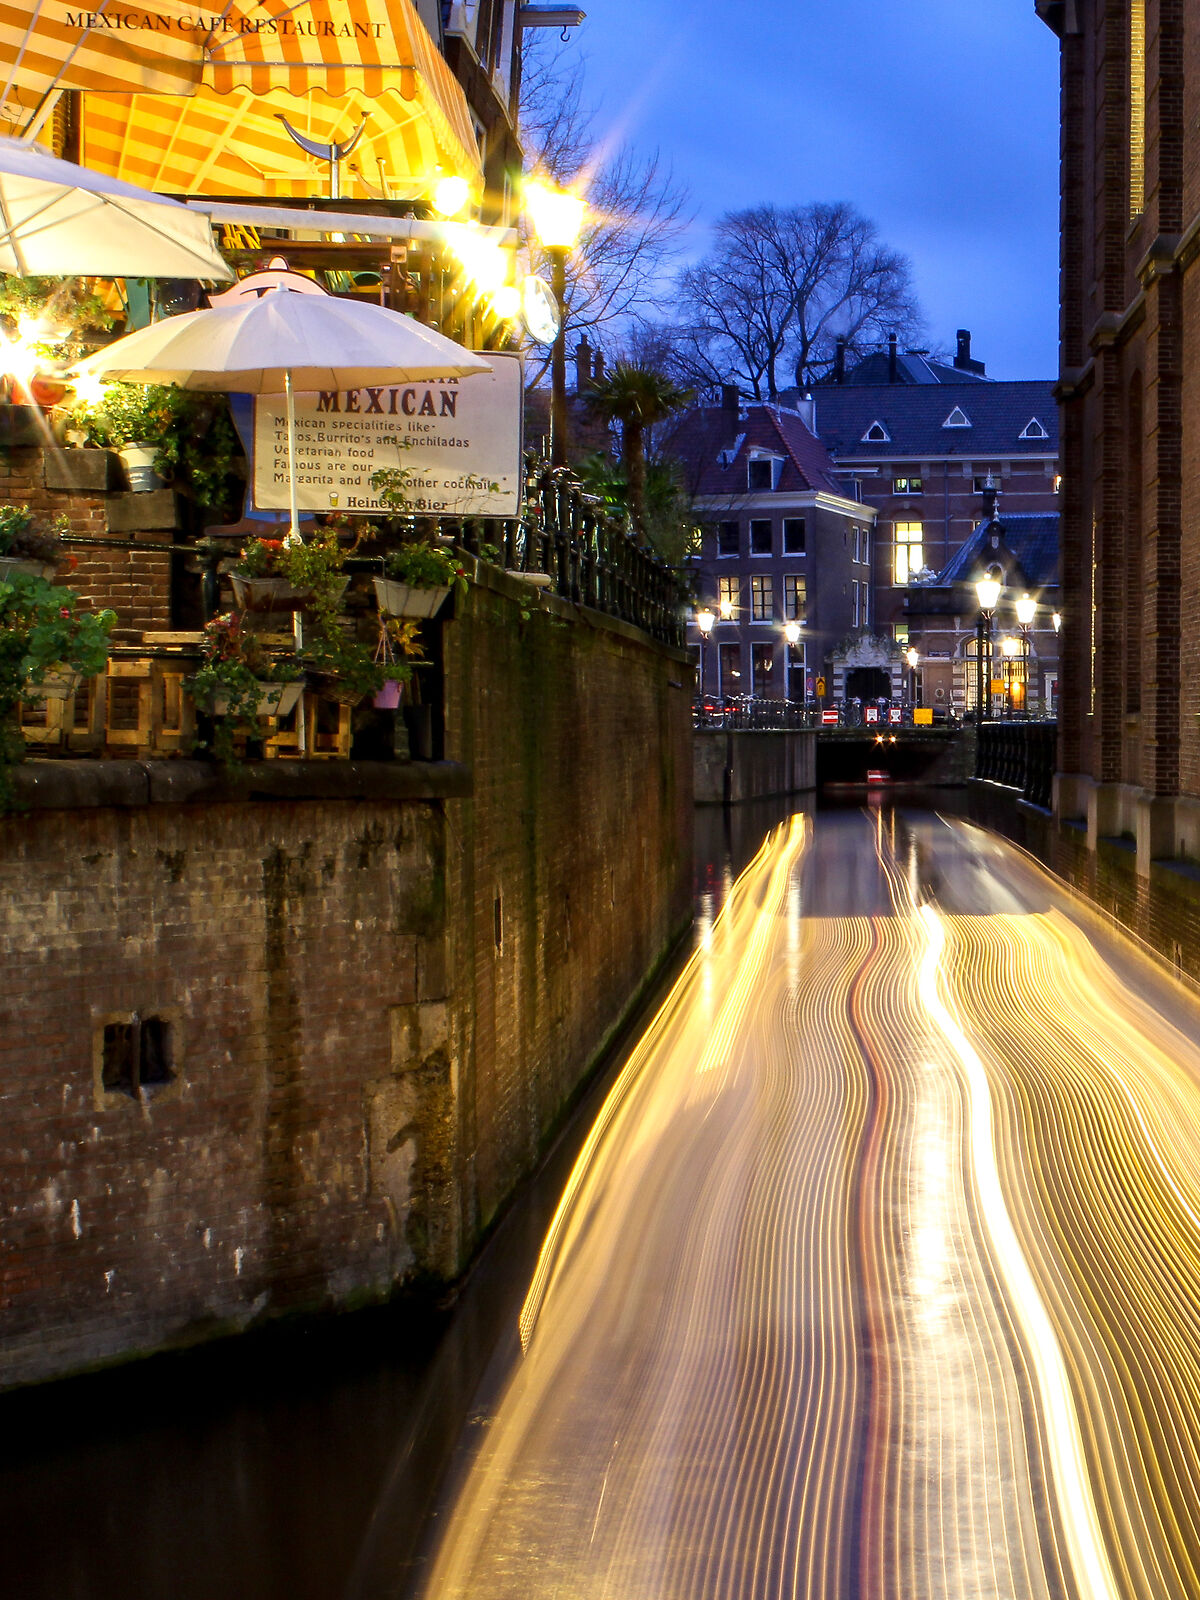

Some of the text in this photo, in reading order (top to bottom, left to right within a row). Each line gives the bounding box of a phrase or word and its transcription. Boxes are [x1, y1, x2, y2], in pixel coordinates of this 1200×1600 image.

[65, 12, 386, 38] MEXICAN CAFÉ RESTAURANT
[316, 387, 459, 418] MEXICAN
[274, 417, 326, 429] Mxican
[331, 419, 402, 433] specialities
[376, 435, 398, 446] and
[404, 435, 470, 448] Enchiladas
[274, 444, 374, 458] Veetarian food
[327, 462, 346, 471] are
[352, 463, 374, 472] our
[273, 472, 334, 485] Magarita
[339, 475, 361, 485] and
[405, 478, 439, 489] other
[443, 478, 497, 490] cocktail
[418, 499, 447, 511] Bier
